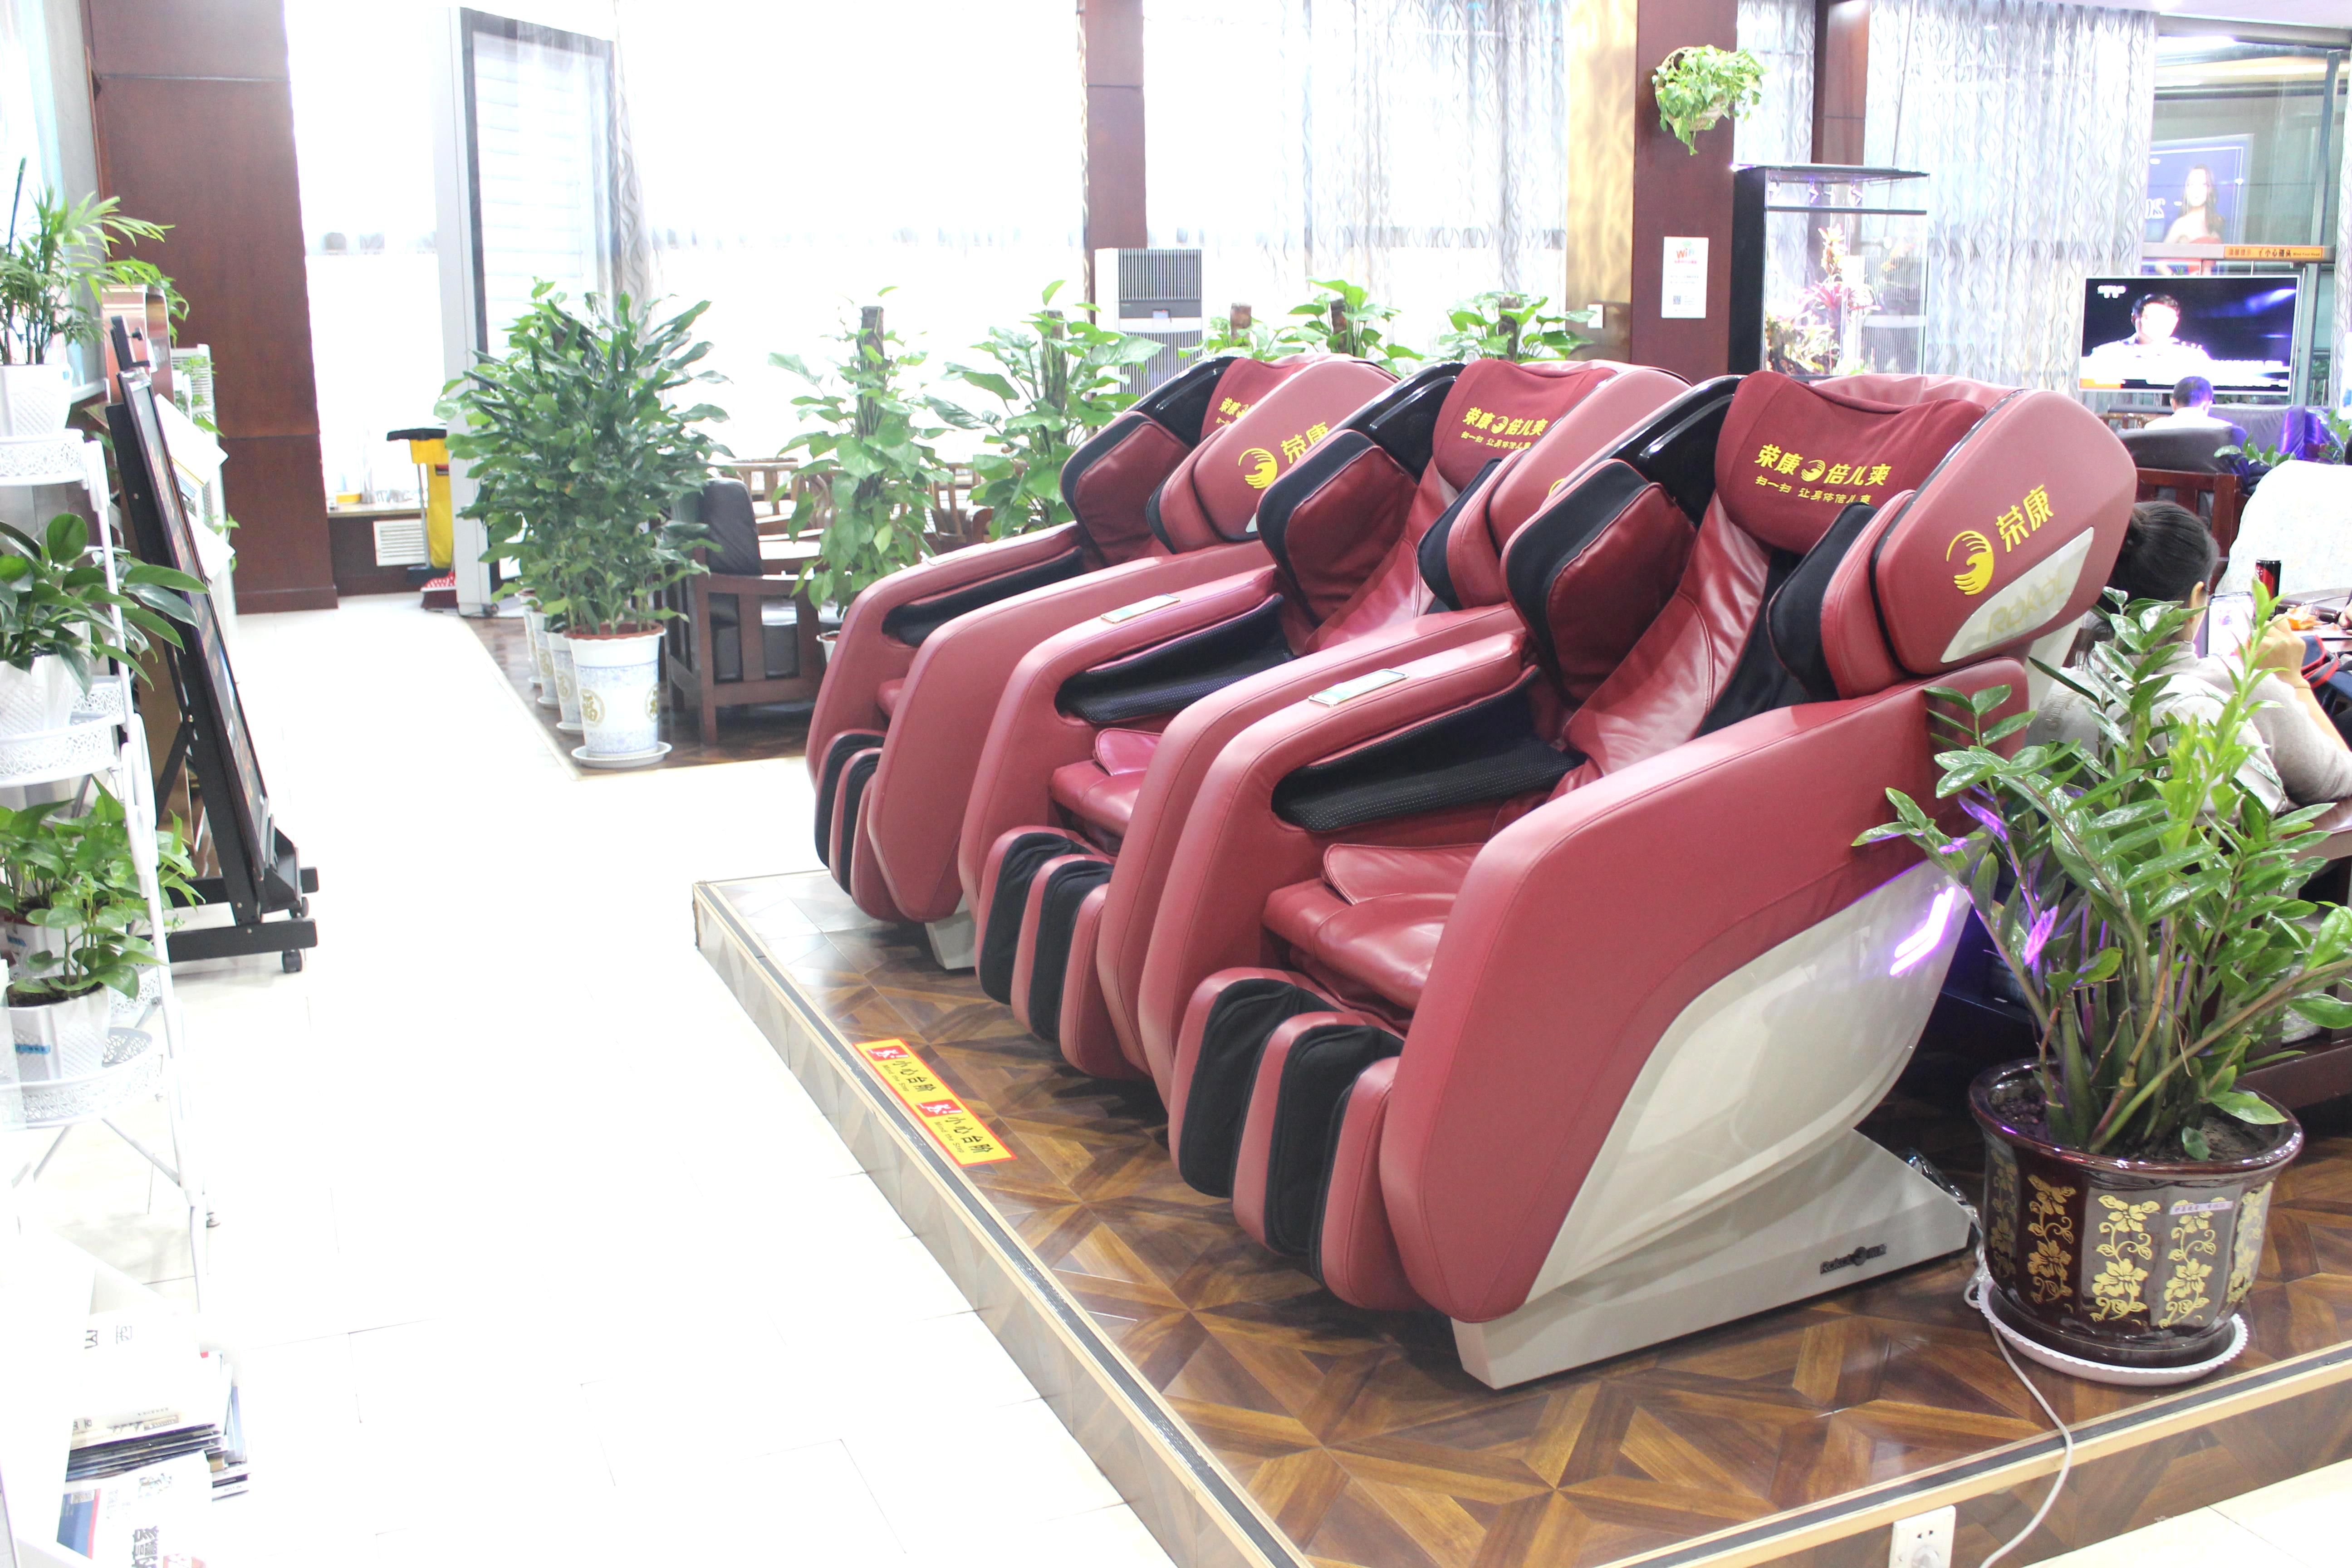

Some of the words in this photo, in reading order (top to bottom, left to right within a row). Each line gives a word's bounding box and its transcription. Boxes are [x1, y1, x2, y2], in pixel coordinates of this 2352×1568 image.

[1460, 431, 1484, 443] 扫一扫
[1462, 407, 1495, 429] 荣康
[1504, 418, 1548, 436] 倍儿爽
[1280, 421, 1328, 464] 荣康
[1754, 444, 1803, 475] 荣康
[1823, 463, 1891, 486] 倍儿爽
[1755, 475, 1792, 493] 扫一扫
[1995, 484, 2054, 553] 荣康
[892, 1061, 937, 1092] 小心台阶
[934, 1122, 948, 1132] Mind
[953, 1143, 965, 1153] Step
[945, 1117, 994, 1153] 小心台阶
